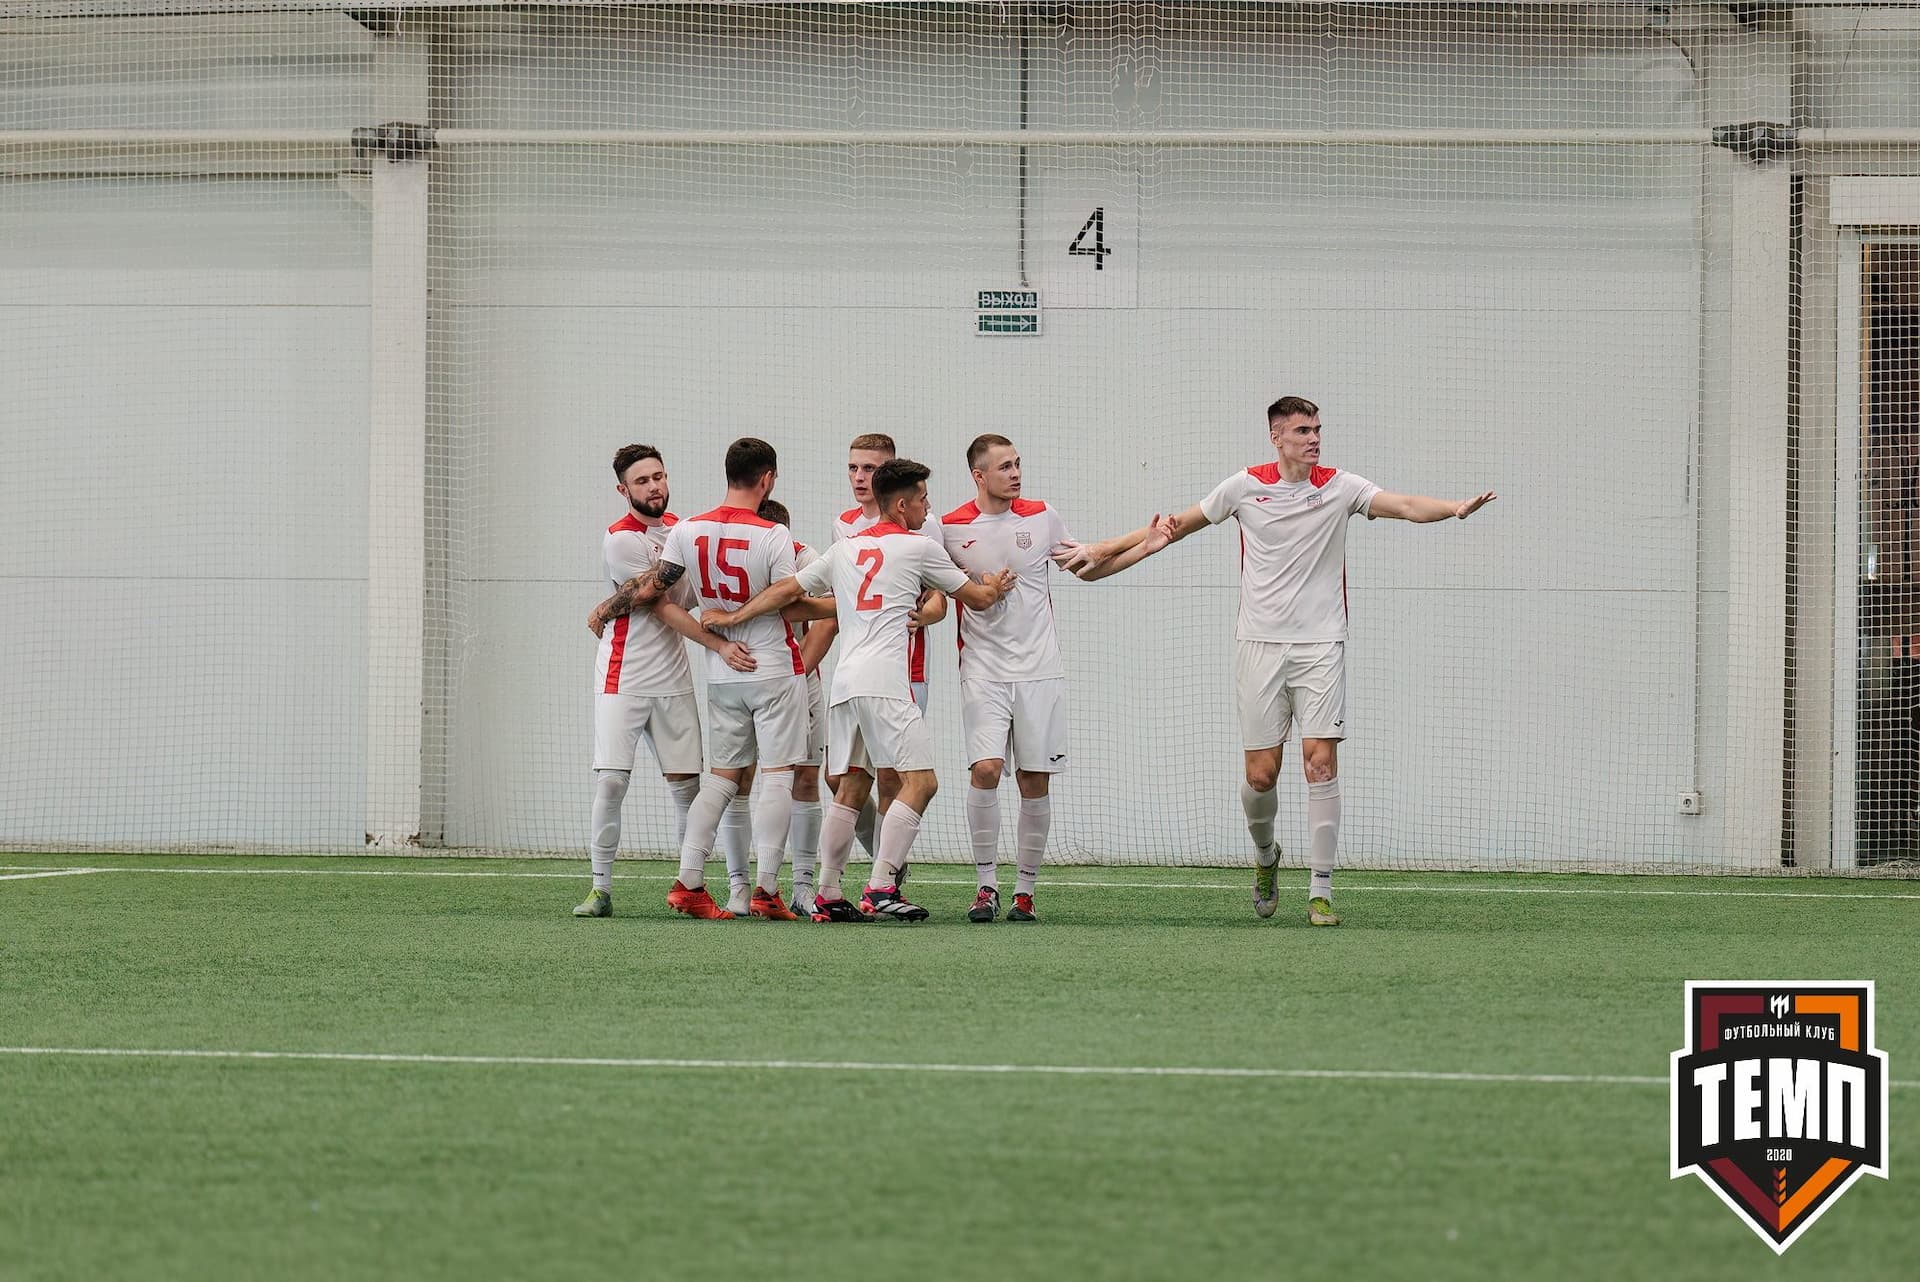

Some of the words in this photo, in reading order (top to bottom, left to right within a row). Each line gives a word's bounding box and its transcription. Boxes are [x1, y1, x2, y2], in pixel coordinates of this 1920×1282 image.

[1068, 207, 1112, 270] 4
[982, 292, 1036, 307] ВЫХОД
[694, 535, 751, 604] 15
[855, 548, 885, 611] 2
